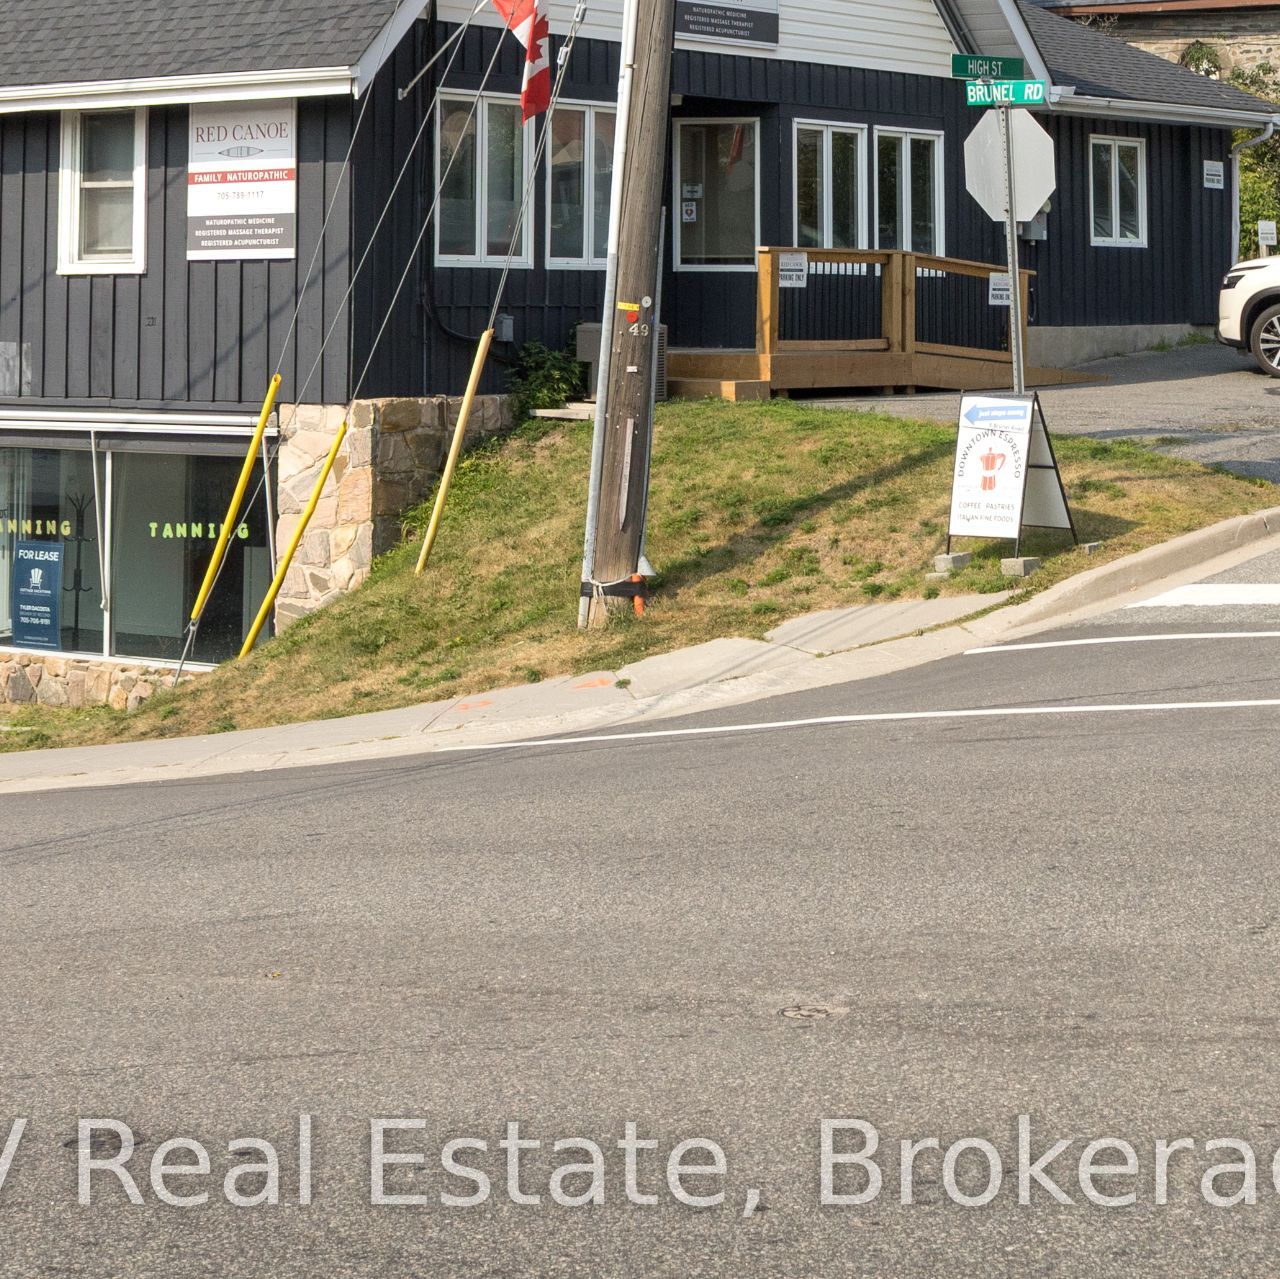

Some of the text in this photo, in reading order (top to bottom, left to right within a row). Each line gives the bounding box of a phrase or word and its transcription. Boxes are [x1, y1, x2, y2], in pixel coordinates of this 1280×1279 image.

[692, 7, 747, 19] NATUROPATHIC MEDICINE
[684, 14, 754, 29] REGISTERED MASSAGE THERAPIST
[689, 24, 750, 37] REGISTERED ACUPUNCTURIST
[967, 59, 1003, 76] HIGH ST
[967, 83, 1043, 102] BRUNEL RD
[195, 121, 289, 143] RED CANOE
[194, 170, 289, 183] FAMILY NATUROPATHIC
[205, 217, 276, 226] NATUROPATHIC MEDICINE
[195, 227, 284, 237] REGISTERED MASSAGE THERAPIST
[201, 238, 280, 247] REGISTERED ACUPUNCTURIST
[628, 323, 649, 337] 49
[957, 428, 1022, 479] DOWNTOWN ESPRESSO
[149, 522, 249, 539] TANNIG
[18, 549, 59, 562] FOR LEASE
